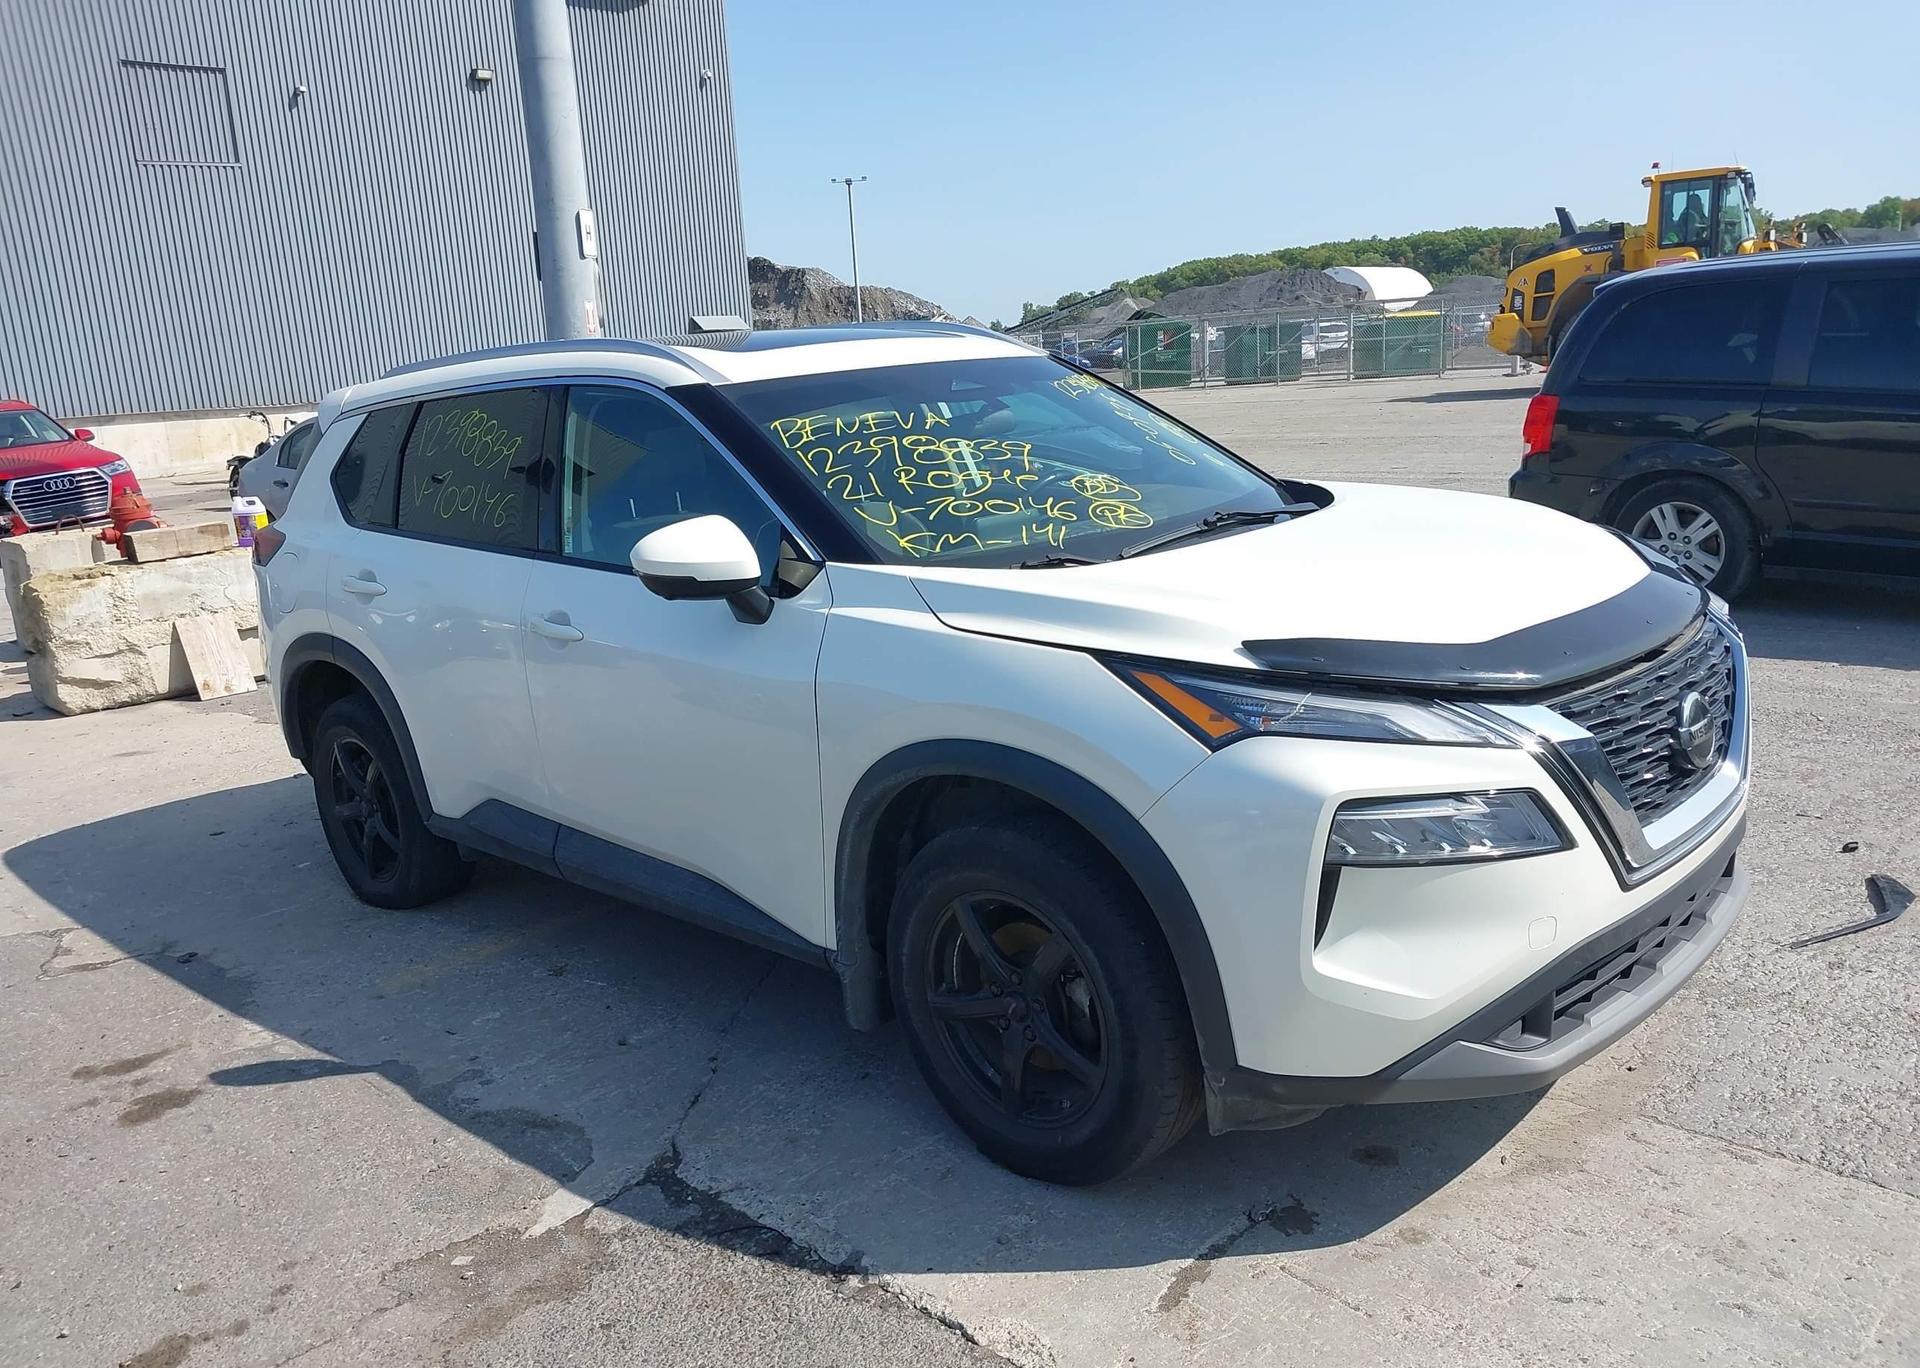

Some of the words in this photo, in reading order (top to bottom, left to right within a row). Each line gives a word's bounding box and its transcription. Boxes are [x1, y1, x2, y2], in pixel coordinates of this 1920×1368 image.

[771, 410, 950, 448] BENEVA
[796, 435, 1032, 477] 12398839
[827, 472, 885, 500] 21
